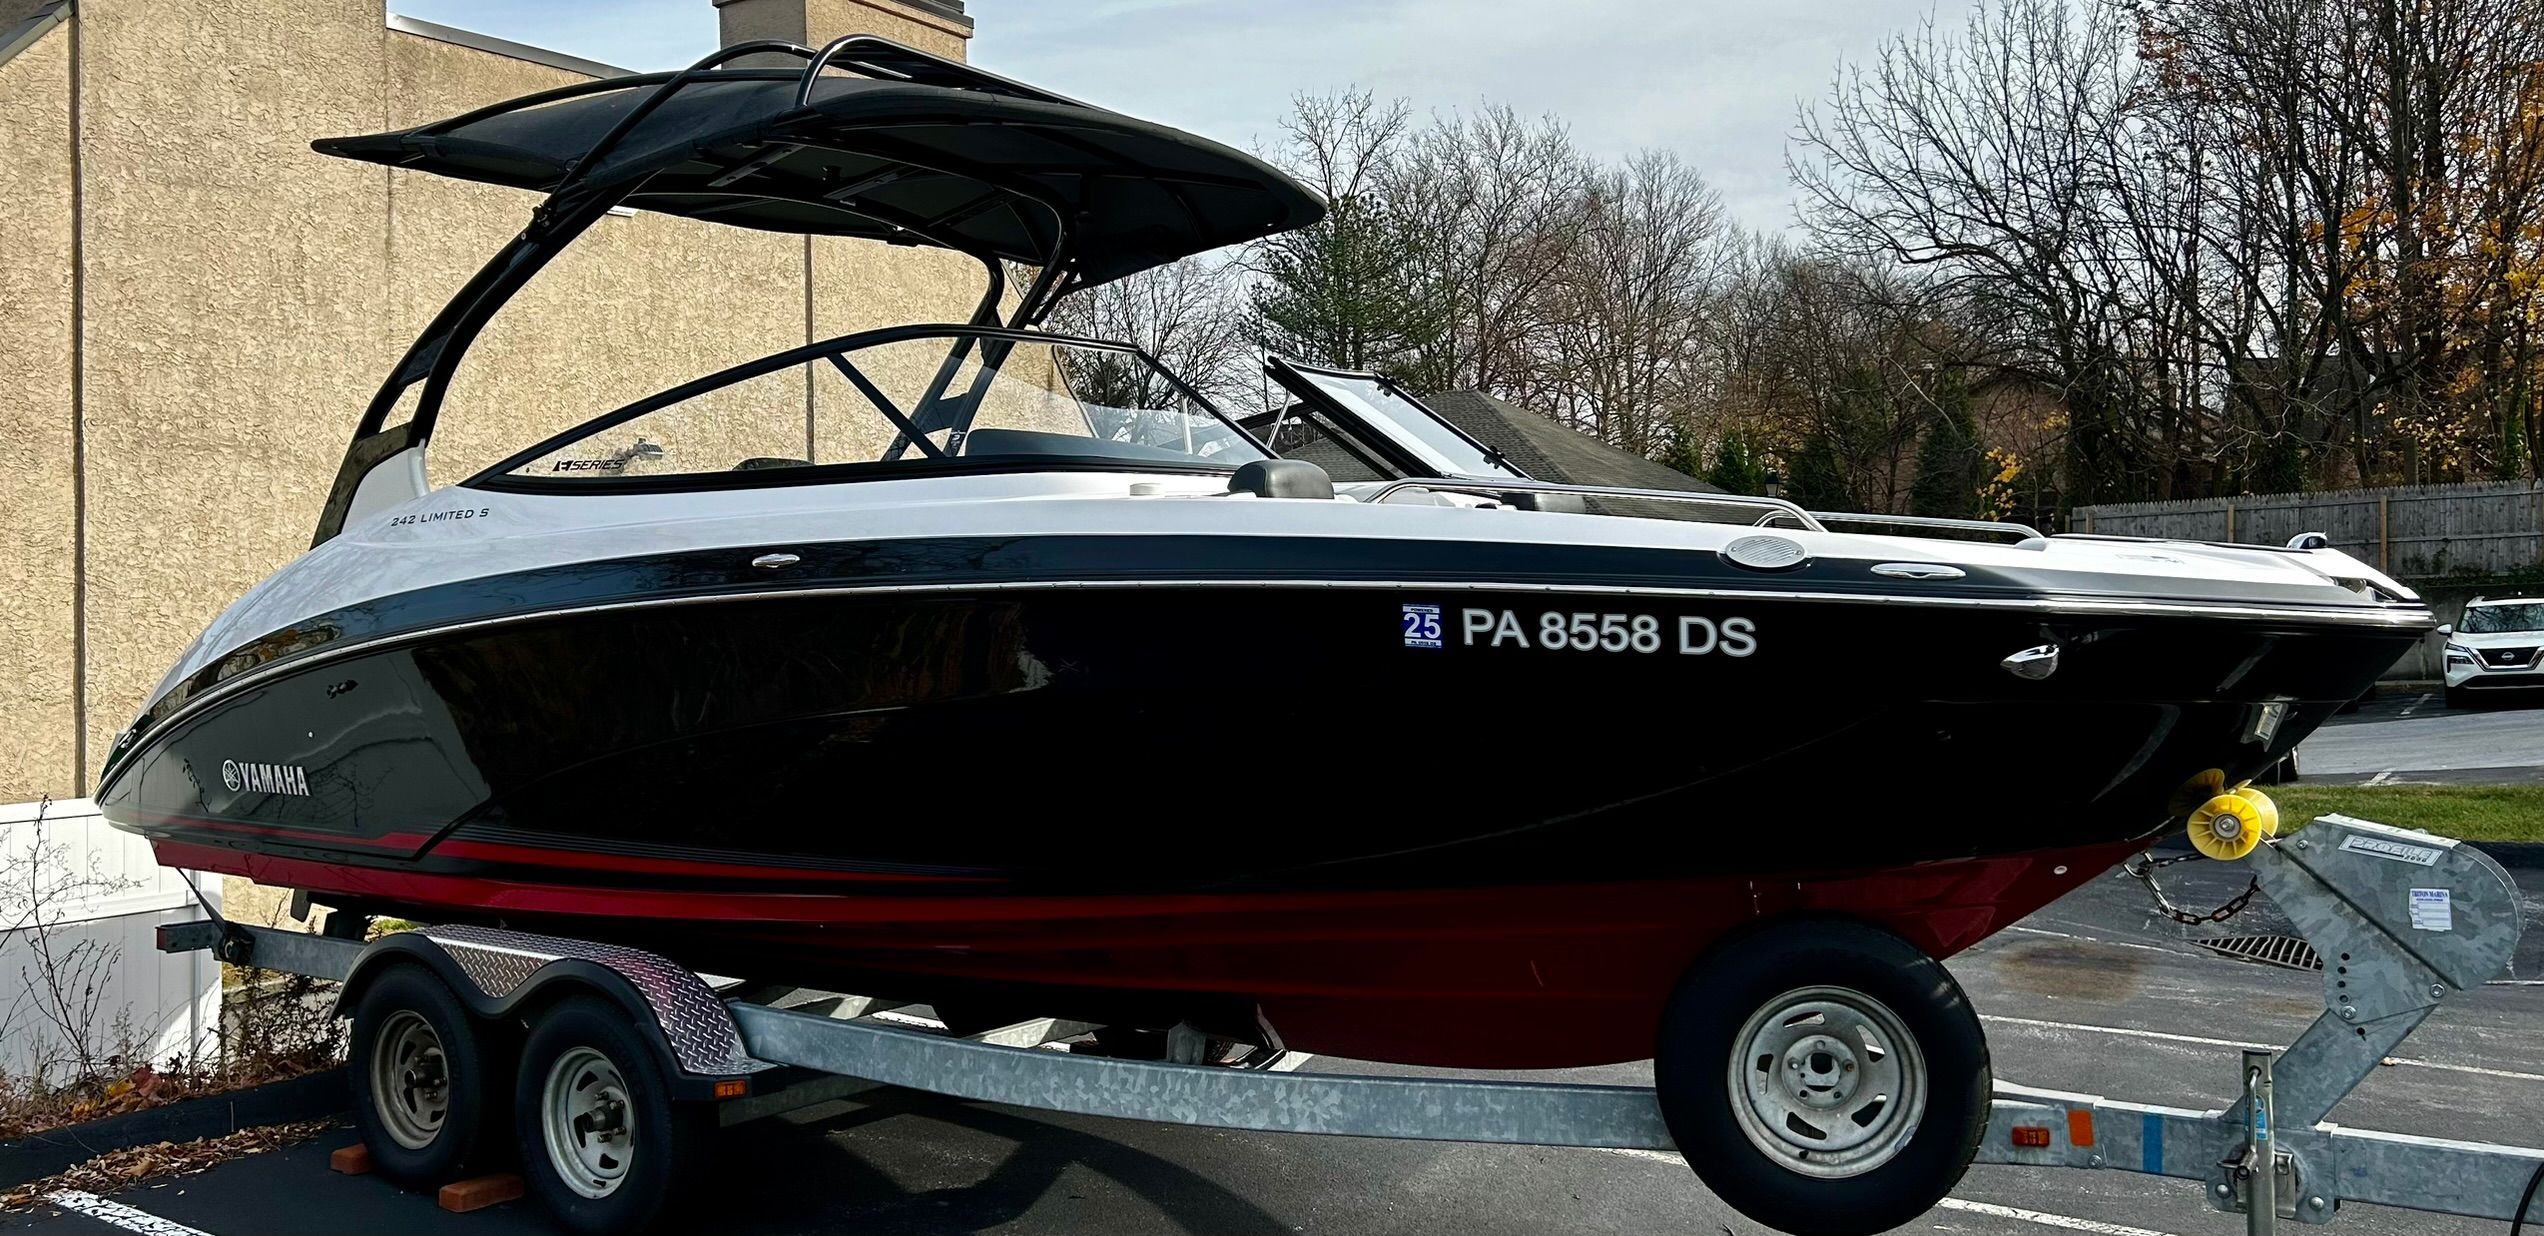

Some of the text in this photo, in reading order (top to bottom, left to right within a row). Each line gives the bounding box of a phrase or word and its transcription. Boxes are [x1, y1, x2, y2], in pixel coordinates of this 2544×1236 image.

[570, 459, 625, 471] SERIES
[391, 508, 490, 527] 242 LIMITED S
[1403, 612, 1441, 639] 25
[1462, 607, 1757, 657] PA 8558 DS
[238, 762, 311, 797] YAMAHA
